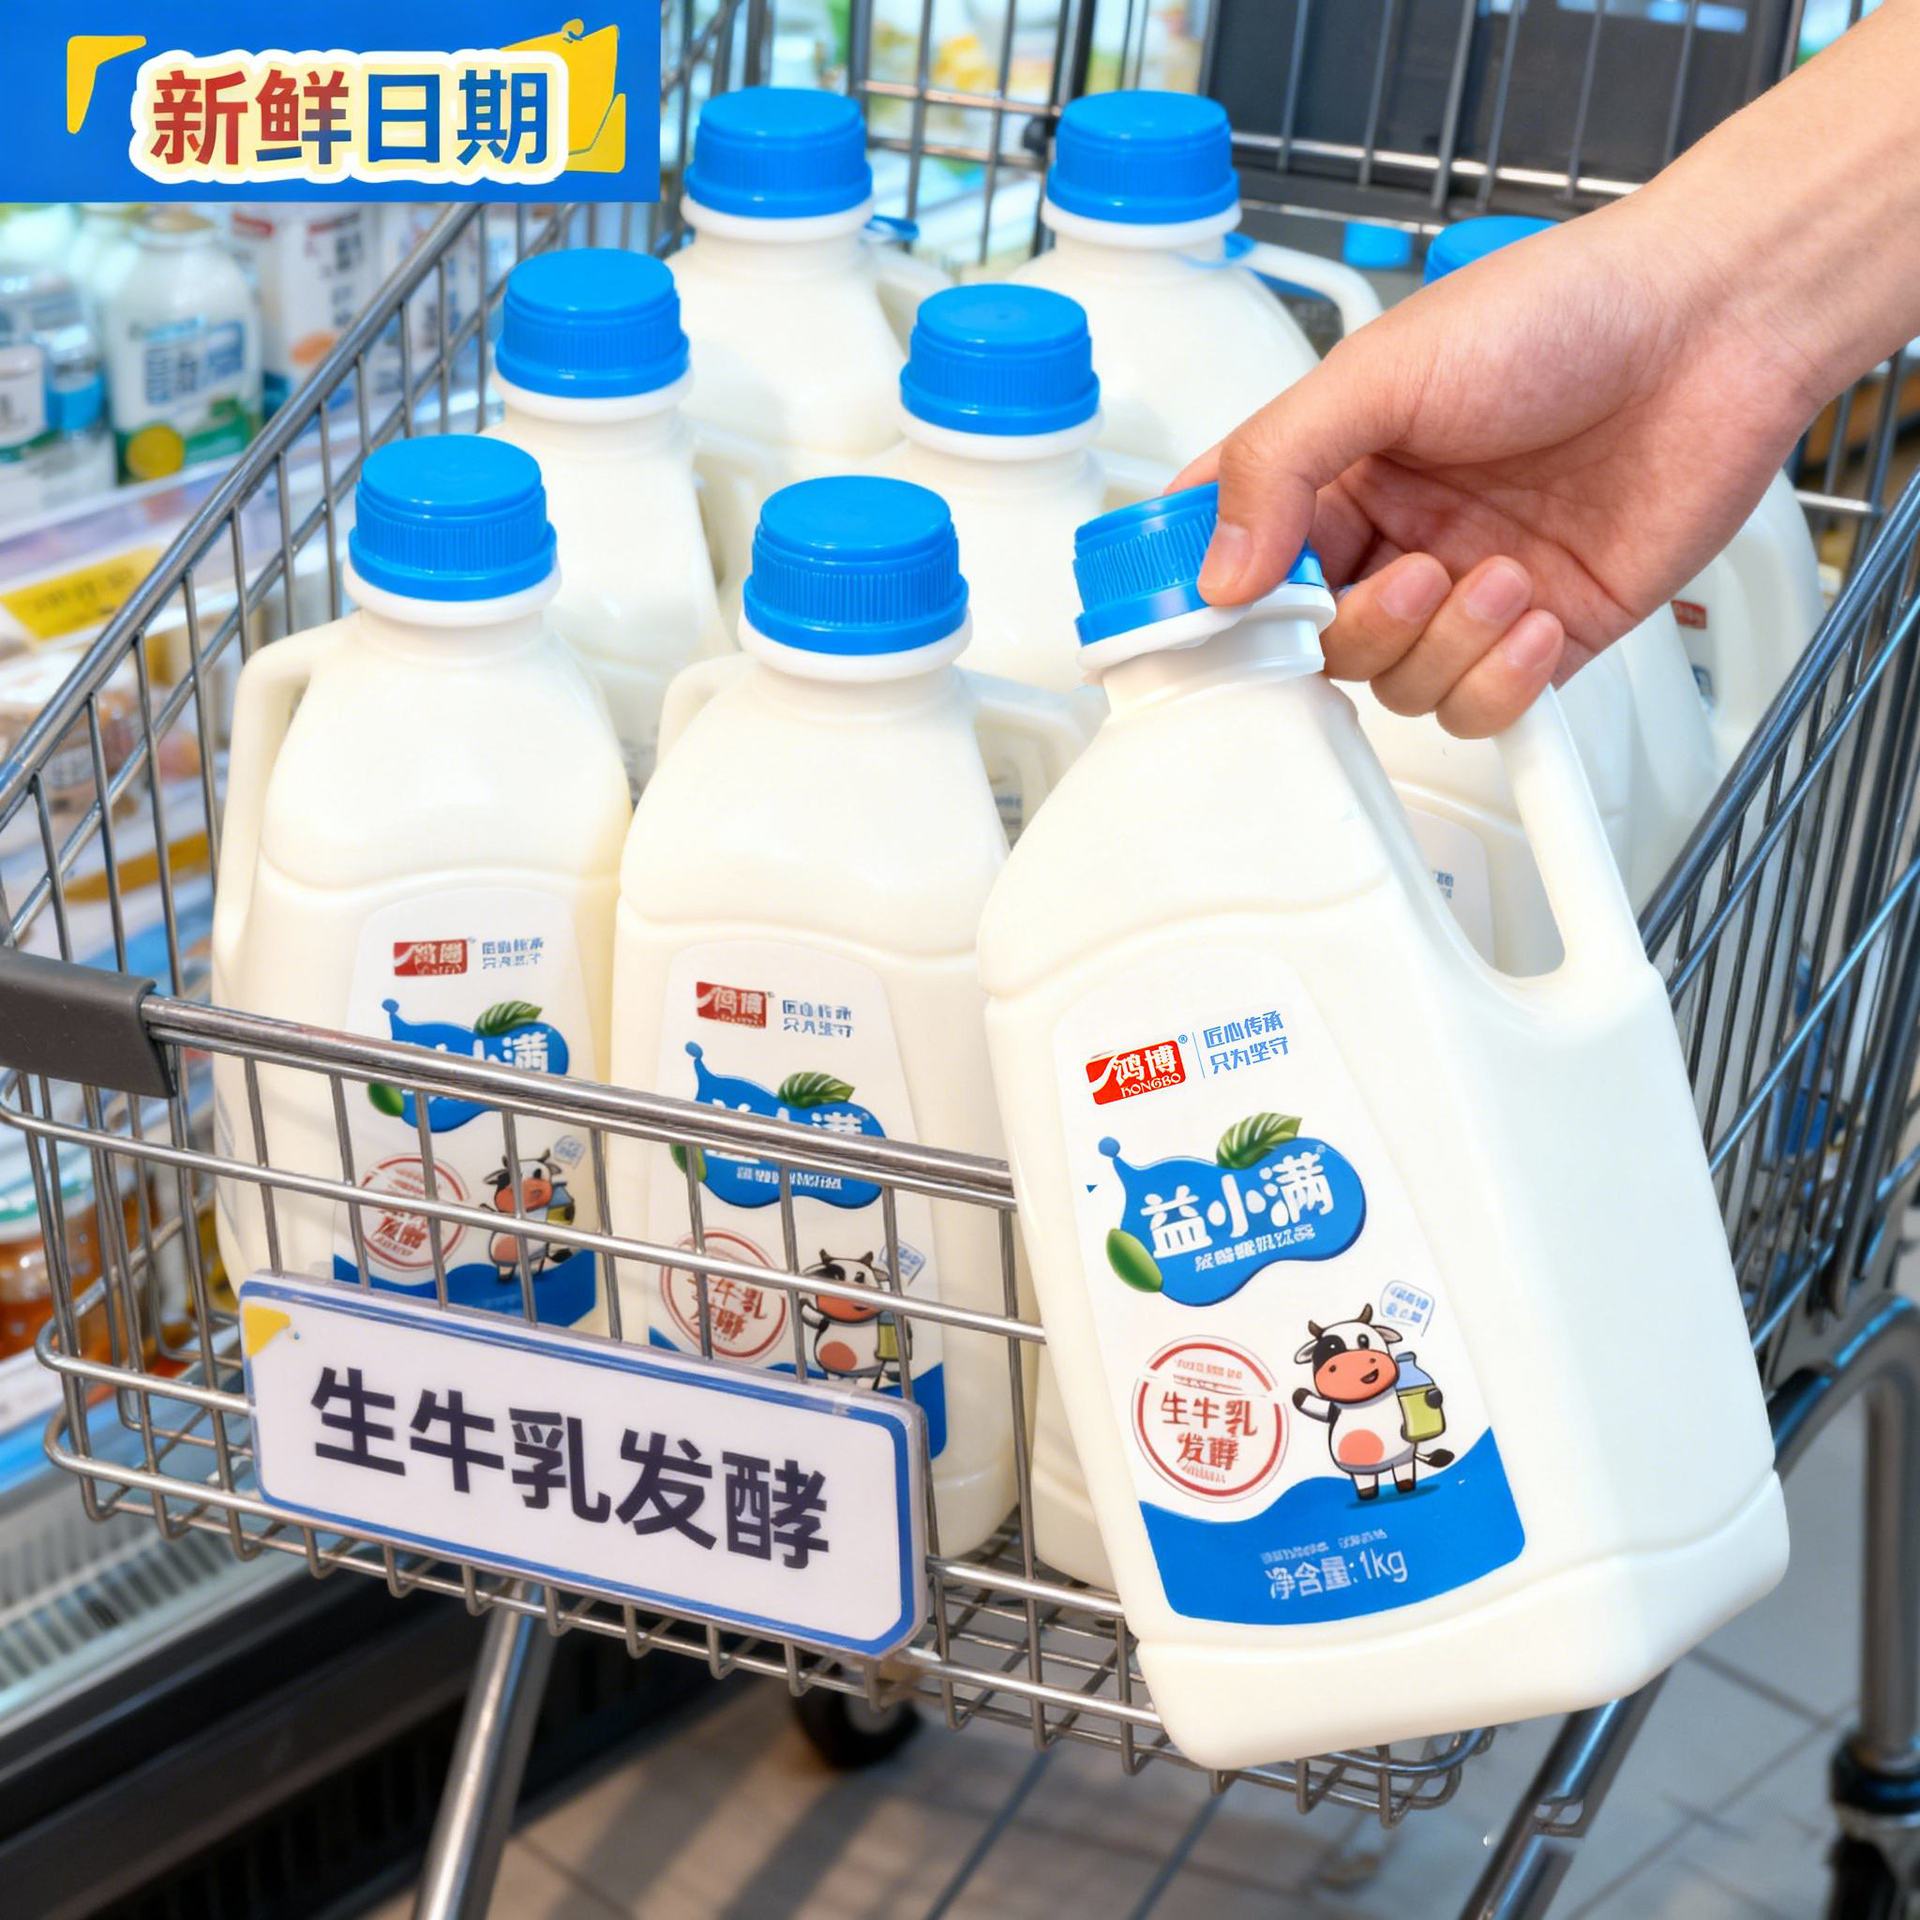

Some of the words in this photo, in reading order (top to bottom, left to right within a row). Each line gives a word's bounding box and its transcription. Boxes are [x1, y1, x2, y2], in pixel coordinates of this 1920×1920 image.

[1202, 1009, 1285, 1050] 匠心传承
[1106, 1044, 1178, 1086] 鸿博
[1210, 1035, 1290, 1075] 只为坚守
[1139, 1151, 1334, 1259] 益小满
[1160, 1390, 1258, 1437] 生牛乳
[310, 1365, 830, 1570] 生牛乳发酵
[1176, 1431, 1240, 1471] 发酵
